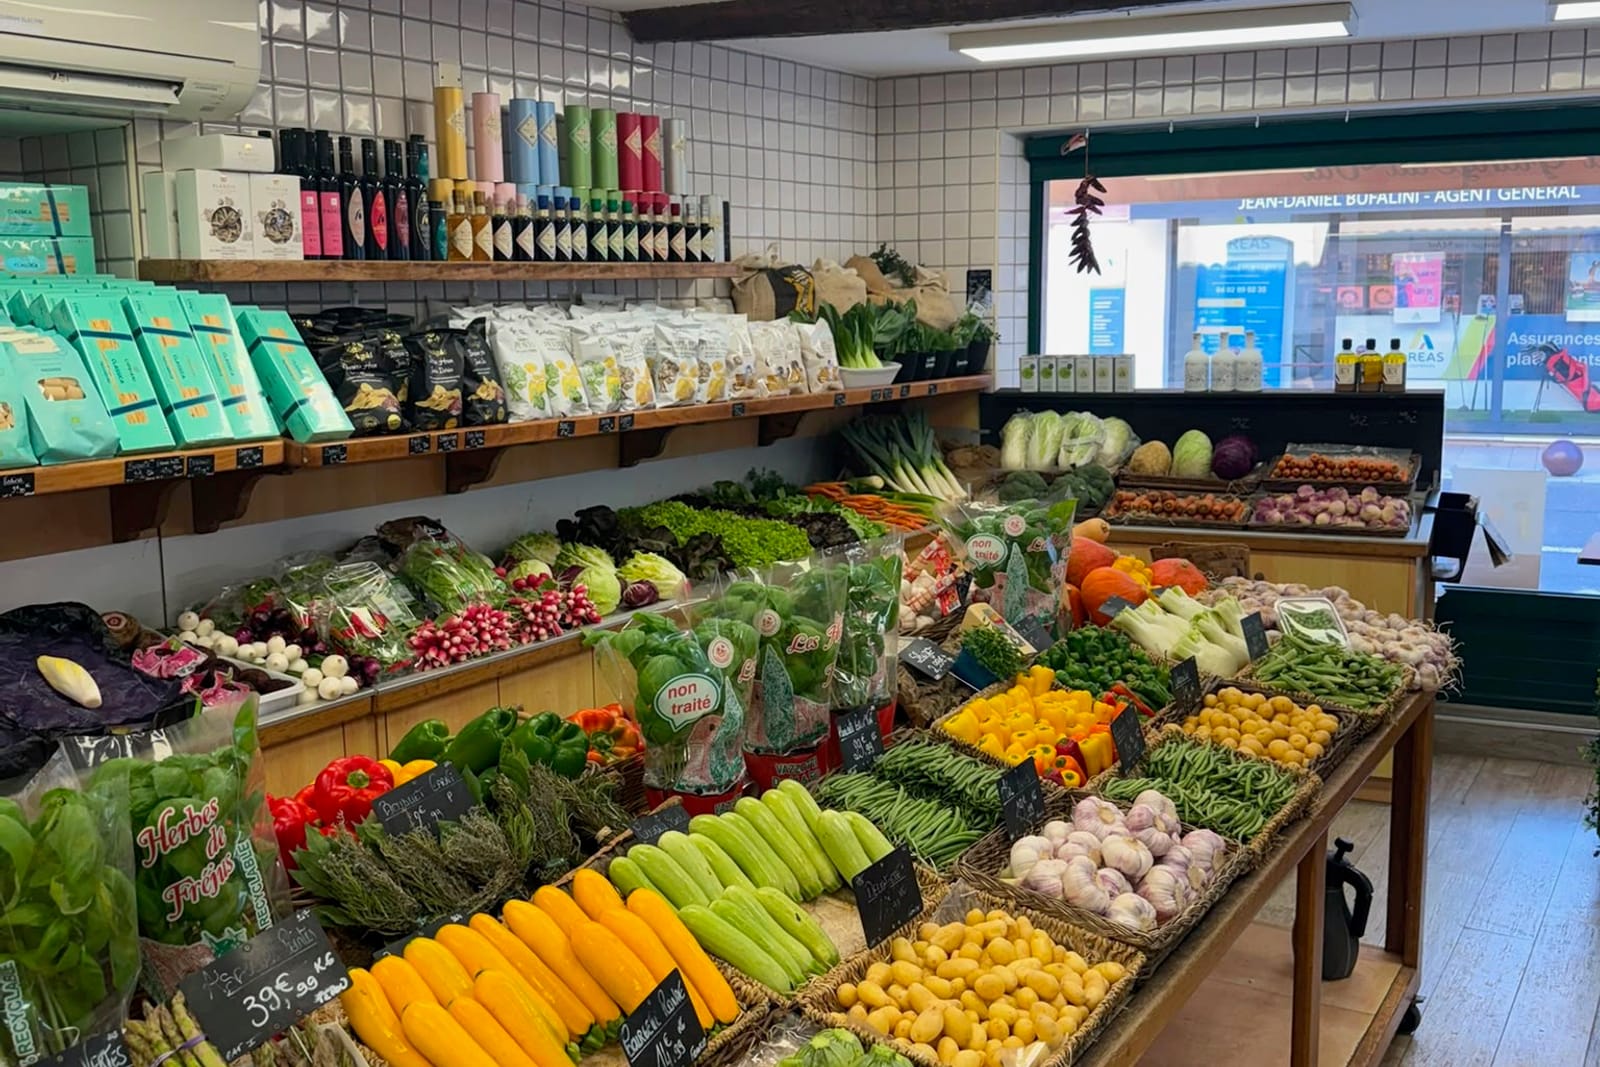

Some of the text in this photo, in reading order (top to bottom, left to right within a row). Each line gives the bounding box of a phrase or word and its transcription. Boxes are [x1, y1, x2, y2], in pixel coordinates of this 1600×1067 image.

[1238, 194, 1342, 210] JEAN-DANIEL
[1434, 189, 1491, 202] AGENT
[667, 683, 697, 699] non
[671, 694, 711, 715] traité
[138, 798, 218, 867] Herbes
[162, 853, 235, 922] Fréjus
[236, 839, 272, 930] RECYCLABLE
[2, 960, 36, 1056] RECYCLABLE
